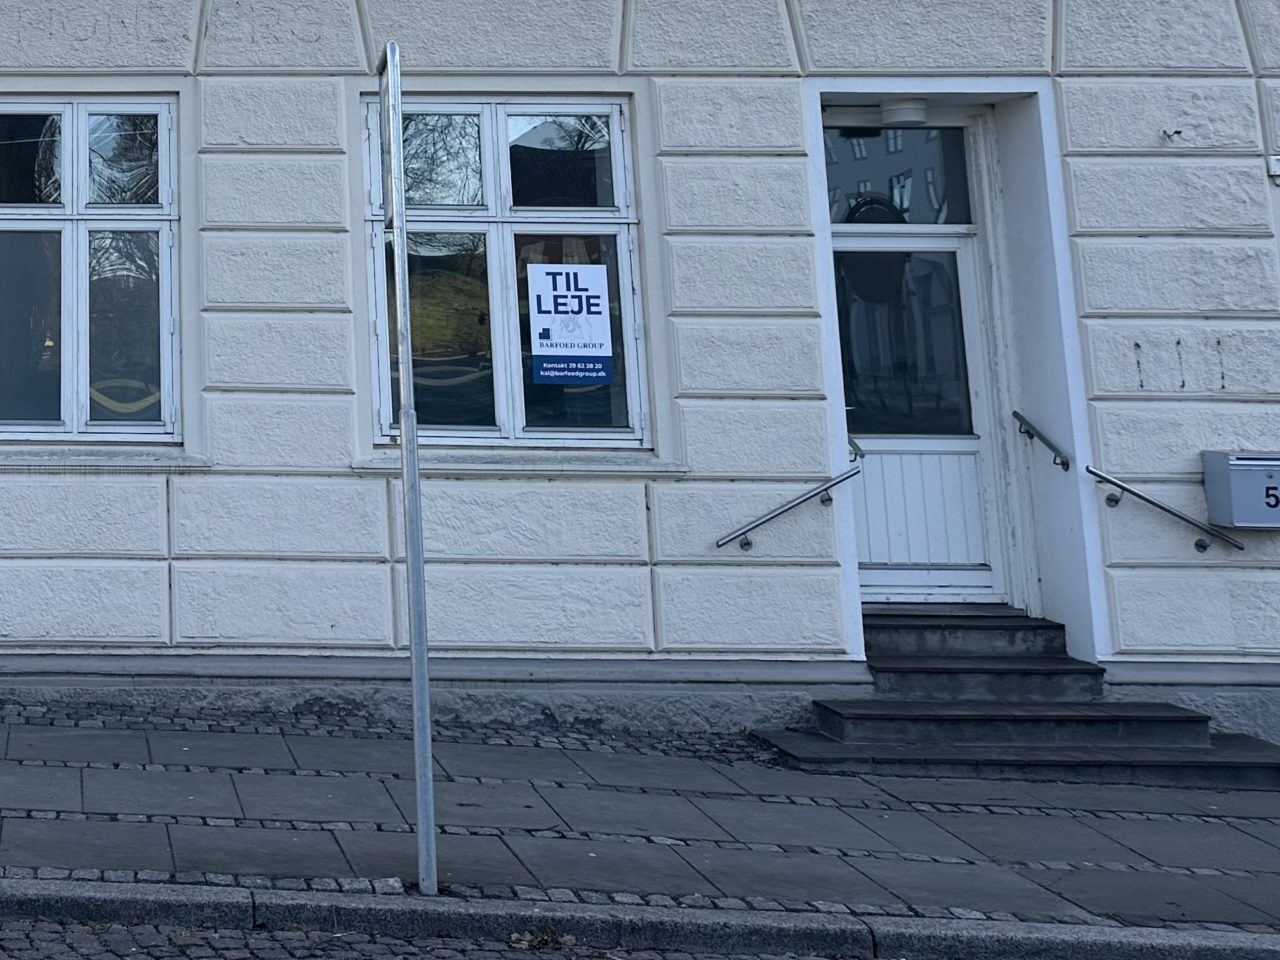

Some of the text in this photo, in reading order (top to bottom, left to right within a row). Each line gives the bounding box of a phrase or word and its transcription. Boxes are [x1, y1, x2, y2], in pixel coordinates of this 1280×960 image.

[545, 271, 589, 292] TIL
[536, 294, 602, 315] LEJE
[539, 341, 576, 349] BARFOED
[1265, 486, 1280, 508] 5
